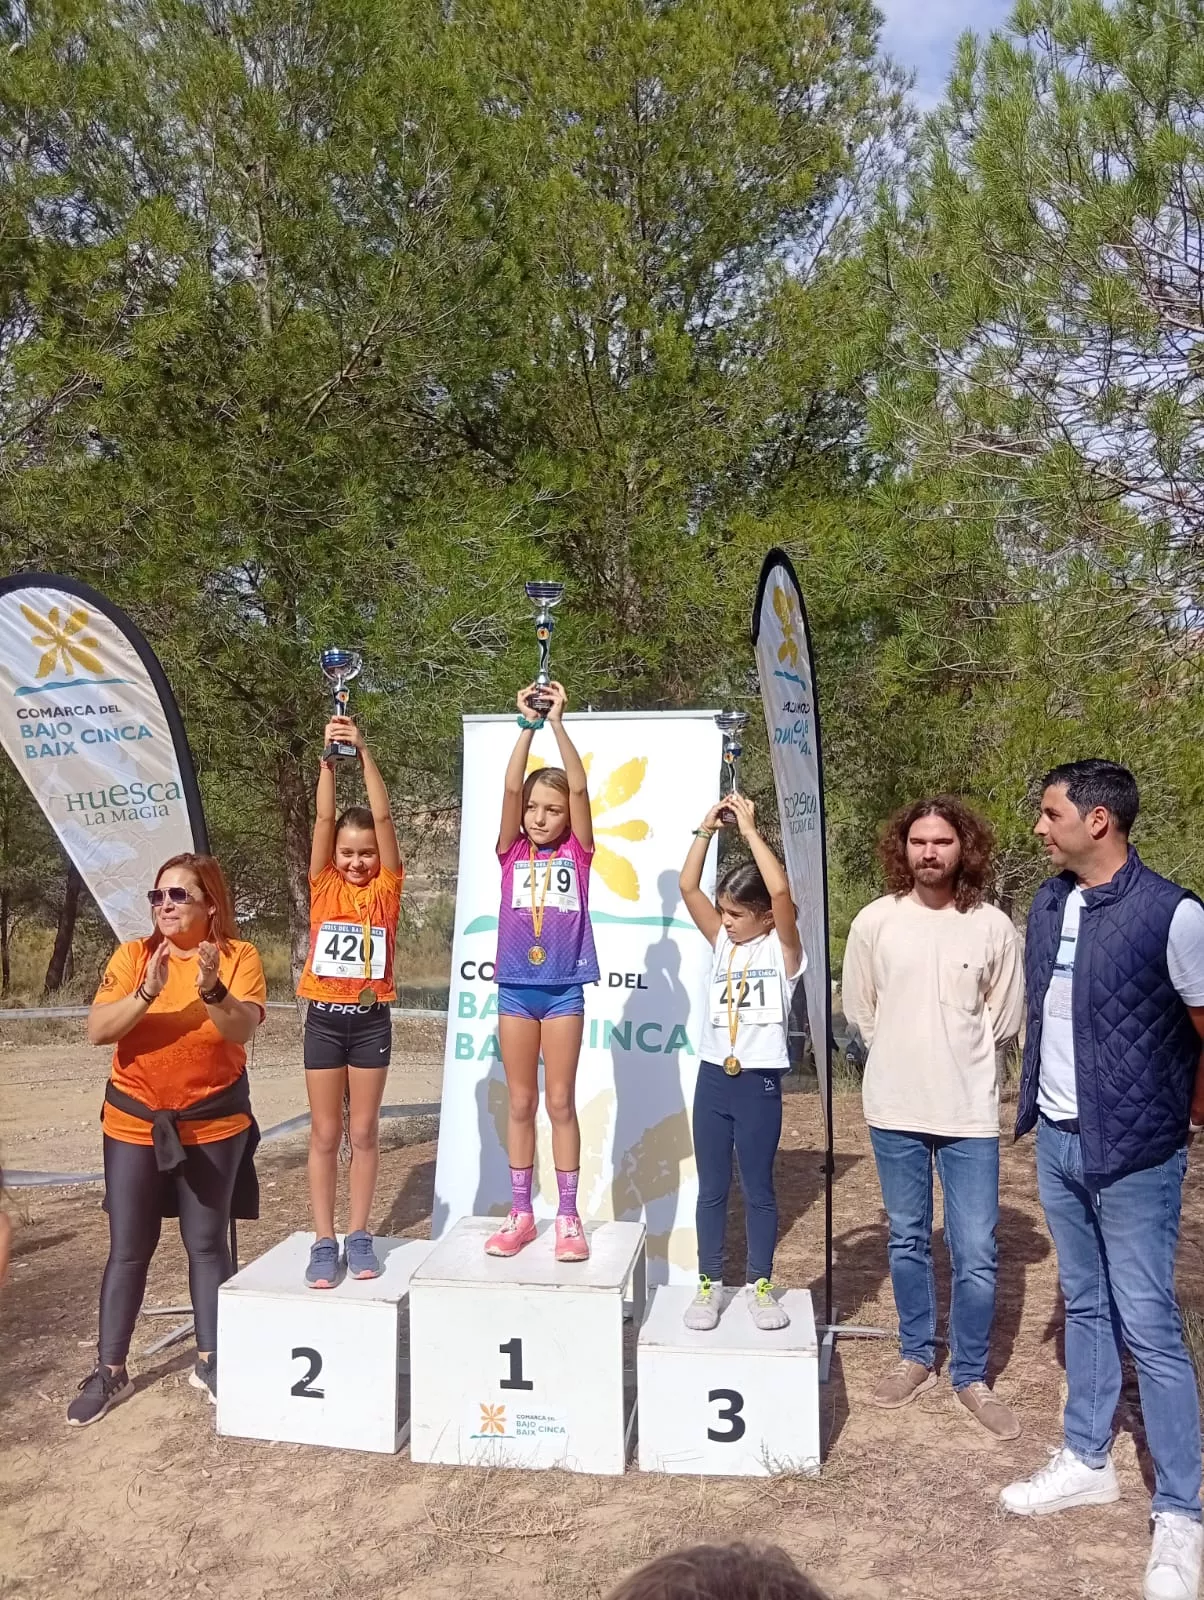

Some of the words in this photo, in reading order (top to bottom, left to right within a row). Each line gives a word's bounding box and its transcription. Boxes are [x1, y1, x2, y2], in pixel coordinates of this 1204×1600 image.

[16, 704, 97, 720] COMARCA
[99, 703, 122, 715] DEL
[19, 721, 73, 742] BAJO
[80, 724, 153, 745] CINCA
[25, 740, 79, 760] BAIX
[523, 868, 571, 893] 419
[324, 933, 375, 963] 420
[608, 972, 648, 990] DEL
[719, 978, 765, 1009] 421
[329, 1002, 372, 1015] PRO
[457, 991, 499, 1020] BA
[454, 1032, 503, 1063] BA
[582, 1018, 696, 1056] INCA
[290, 1346, 326, 1399] 2
[499, 1337, 534, 1391] 1
[516, 1420, 537, 1428] BAJO
[538, 1425, 566, 1434] CINCA
[706, 1388, 747, 1443] 3
[516, 1428, 537, 1436] BAIX
